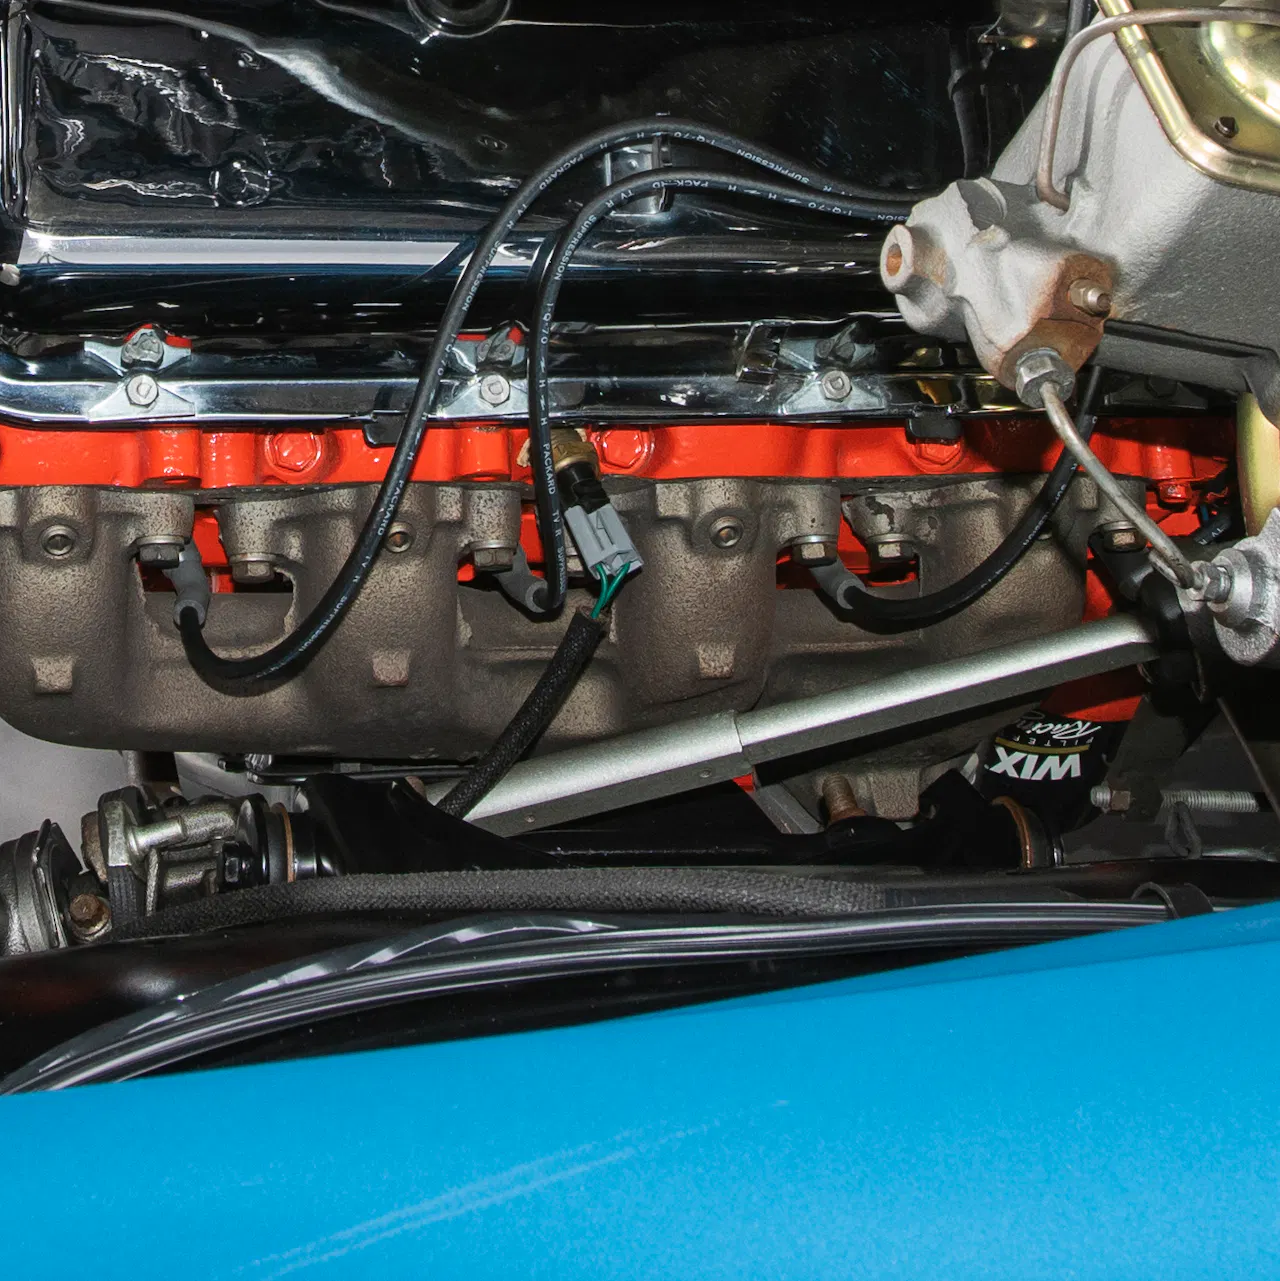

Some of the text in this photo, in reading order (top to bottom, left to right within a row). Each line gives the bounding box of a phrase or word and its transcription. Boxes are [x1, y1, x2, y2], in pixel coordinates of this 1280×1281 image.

[539, 153, 584, 191] PACKARD
[651, 179, 709, 189] PACKRD
[736, 149, 810, 184] SUPPRESSION
[605, 199, 615, 208] R
[620, 189, 634, 200] TV
[553, 214, 597, 281] SUPPRESSION
[461, 240, 501, 312] SUPPRESSION
[543, 444, 557, 495] PACKARD
[377, 479, 405, 537] PACKARD
[551, 512, 560, 524] TV
[554, 529, 562, 537] R
[1211, 526, 1225, 539] TV
[989, 745, 1082, 781] WIX
